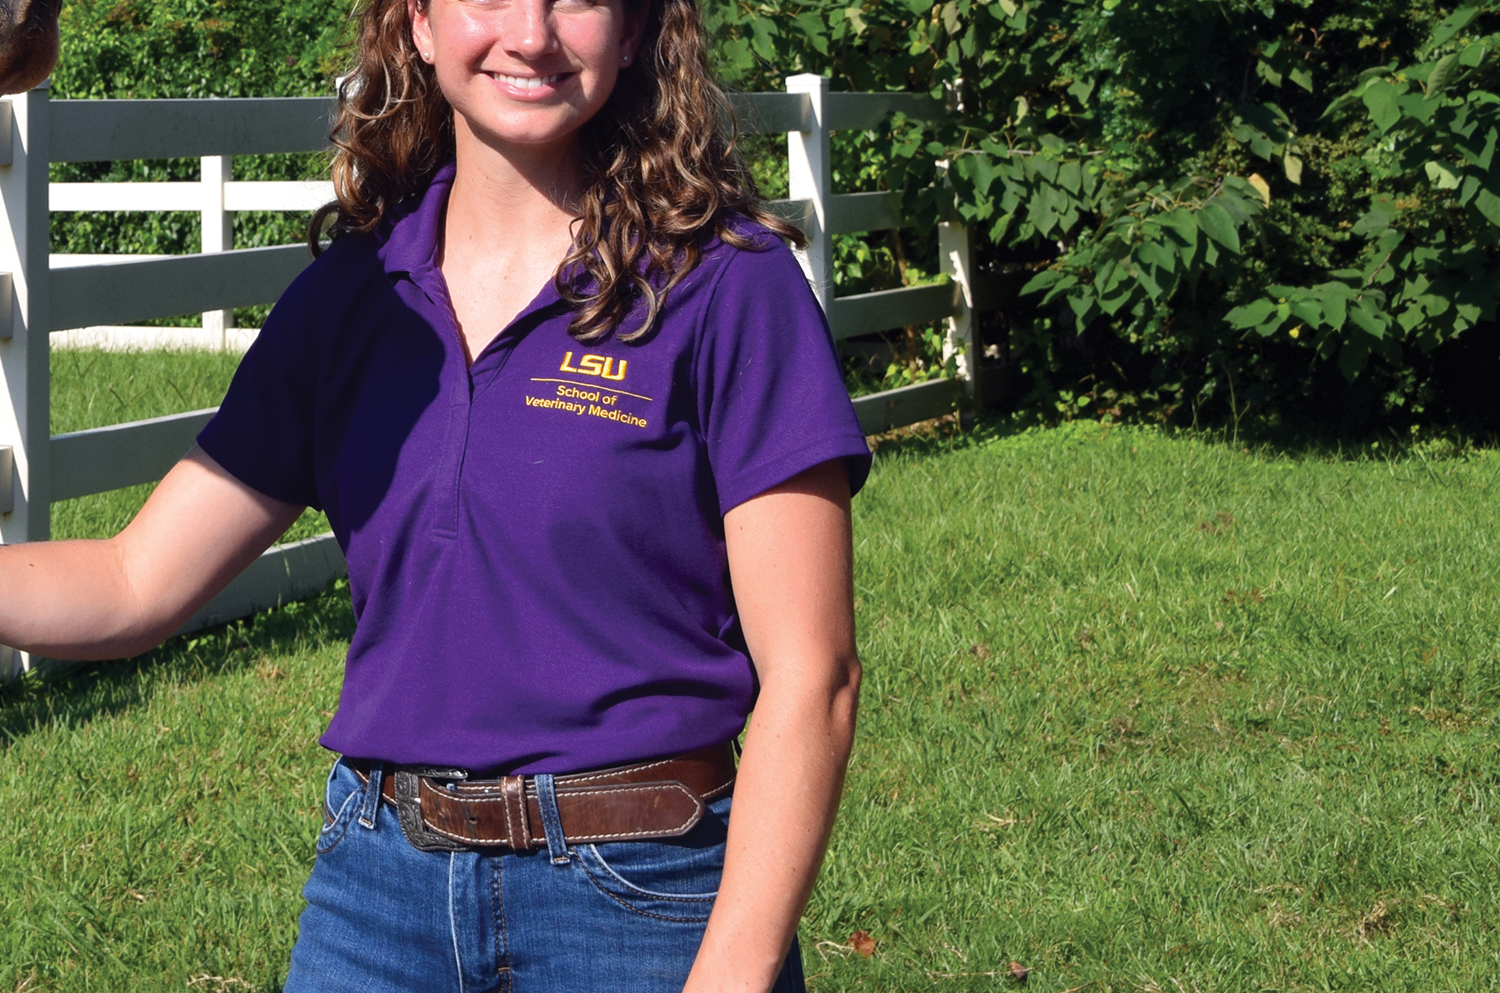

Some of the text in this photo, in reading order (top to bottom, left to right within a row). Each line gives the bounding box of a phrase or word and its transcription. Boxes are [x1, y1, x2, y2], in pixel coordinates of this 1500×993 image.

[559, 351, 628, 381] LSU
[556, 385, 617, 406] School of
[525, 395, 647, 428] Veterinary Medicine
